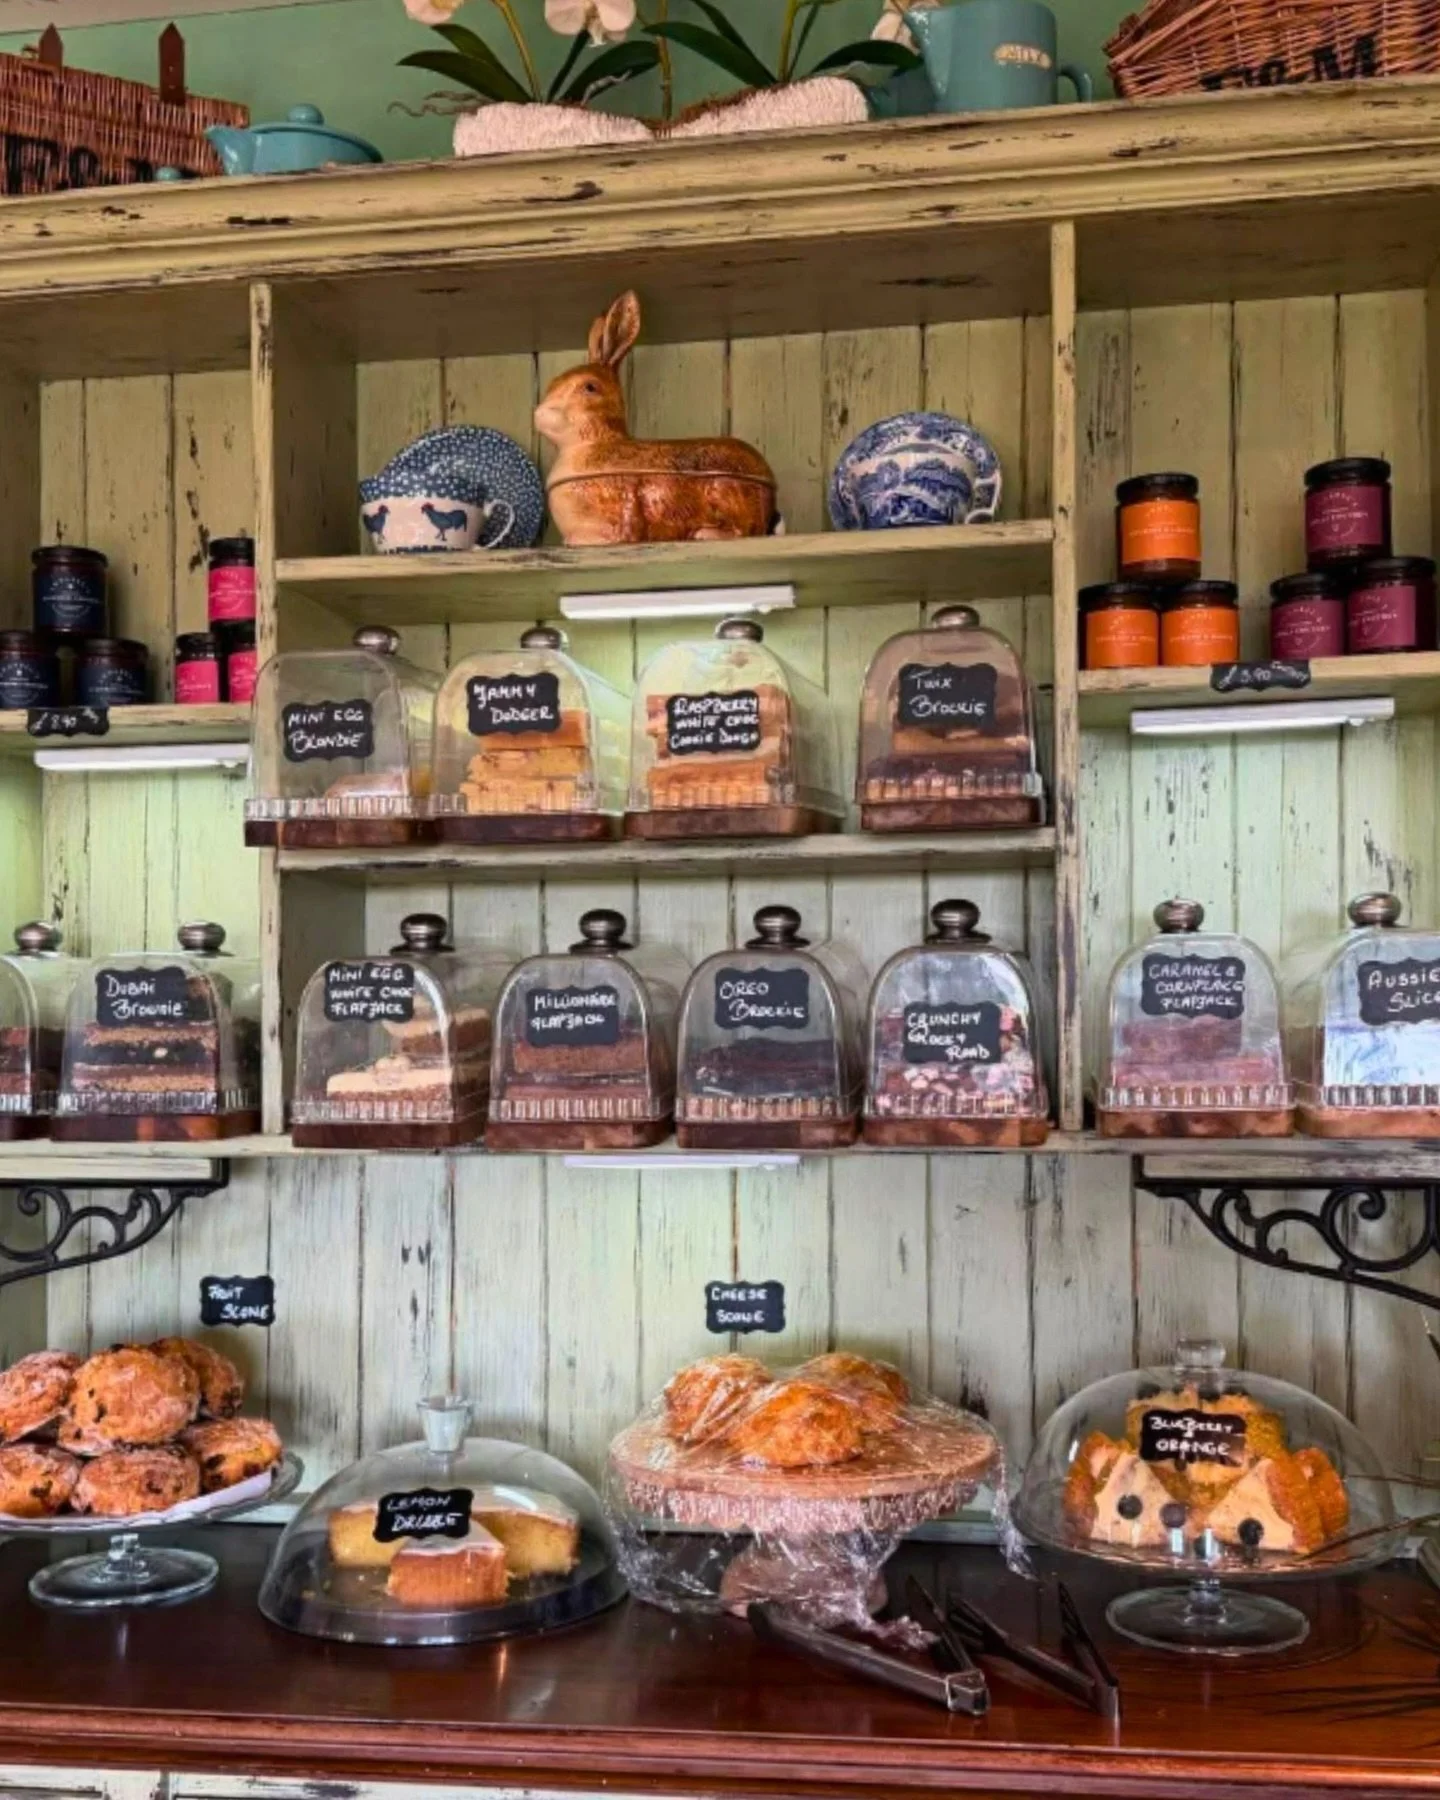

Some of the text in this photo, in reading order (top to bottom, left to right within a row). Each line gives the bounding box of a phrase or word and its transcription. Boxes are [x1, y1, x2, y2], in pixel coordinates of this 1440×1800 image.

[473, 684, 536, 709] JAMMY
[334, 707, 364, 722] EGG
[490, 705, 554, 725] DODGER
[370, 967, 404, 982] EGG
[1149, 962, 1222, 980] CARAMEL
[719, 979, 769, 1000] OREO
[331, 1001, 405, 1019] FLAPJACK
[1160, 994, 1238, 1010] FLAPJACK
[908, 1011, 982, 1028] CRUNCHY
[711, 1286, 768, 1301] CHEESE
[220, 1303, 269, 1320] SCONE
[1155, 1439, 1231, 1456] ORANGE
[387, 1496, 452, 1512] LEMON
